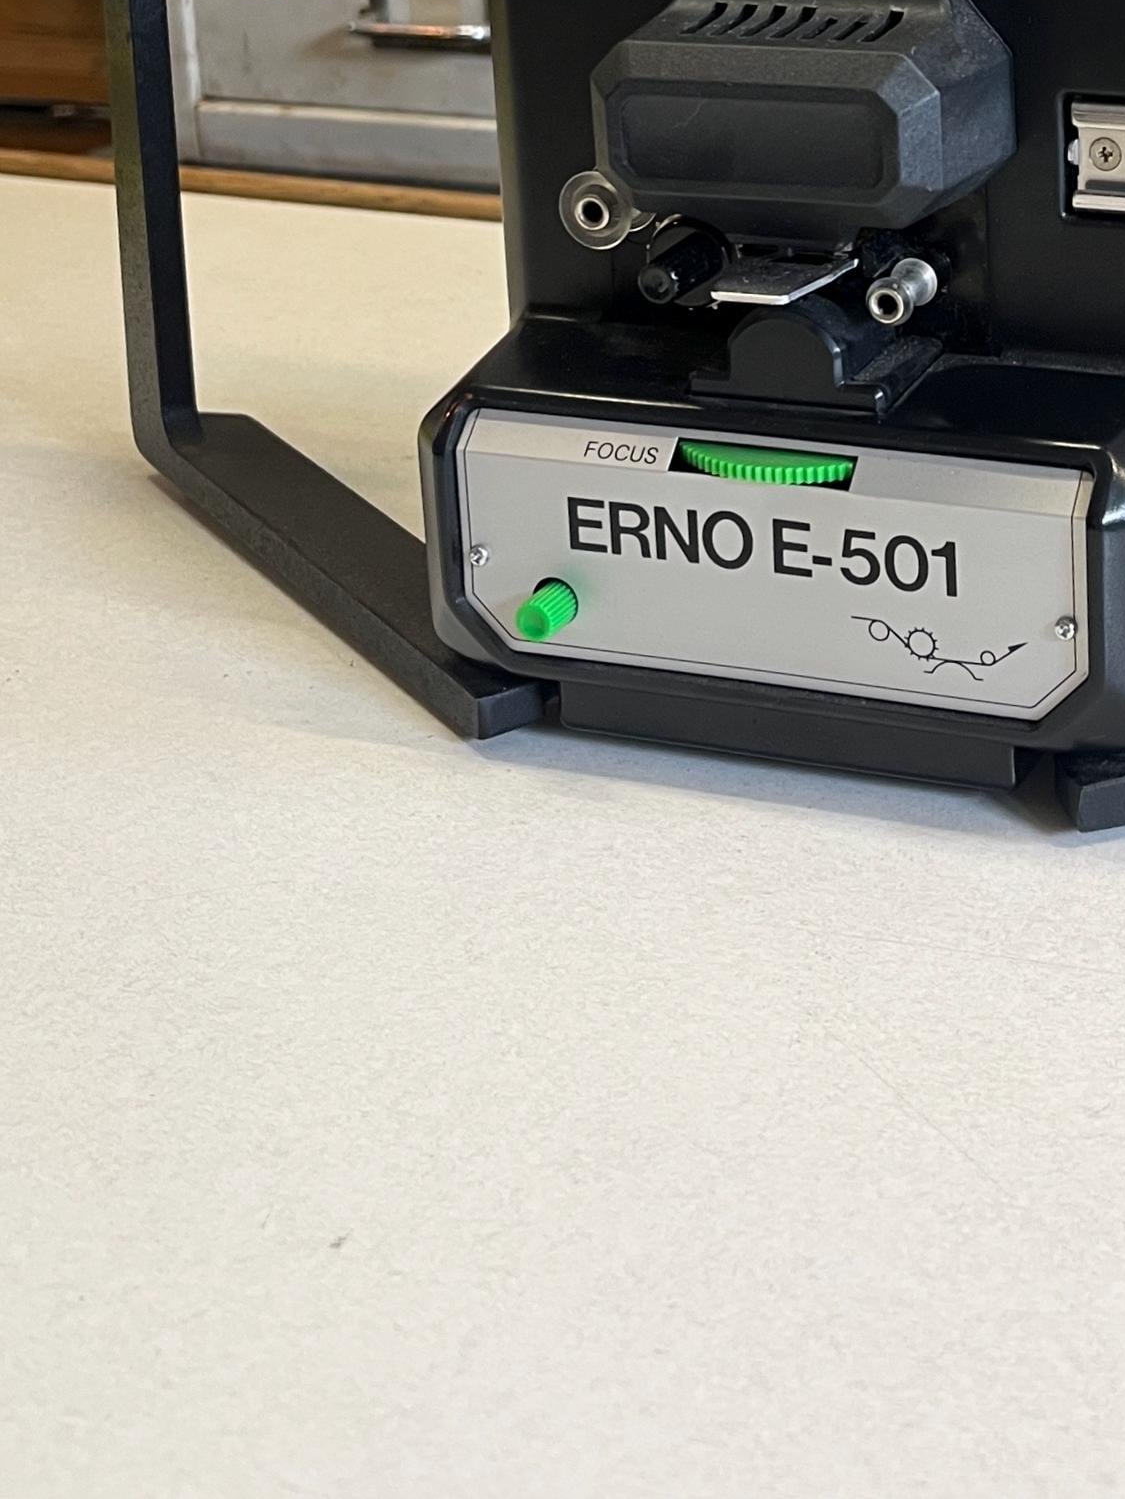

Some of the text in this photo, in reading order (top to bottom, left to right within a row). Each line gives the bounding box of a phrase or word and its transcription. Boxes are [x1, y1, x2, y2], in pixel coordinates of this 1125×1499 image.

[583, 439, 660, 466] FOCUS
[567, 496, 959, 598] ERNO E-501
